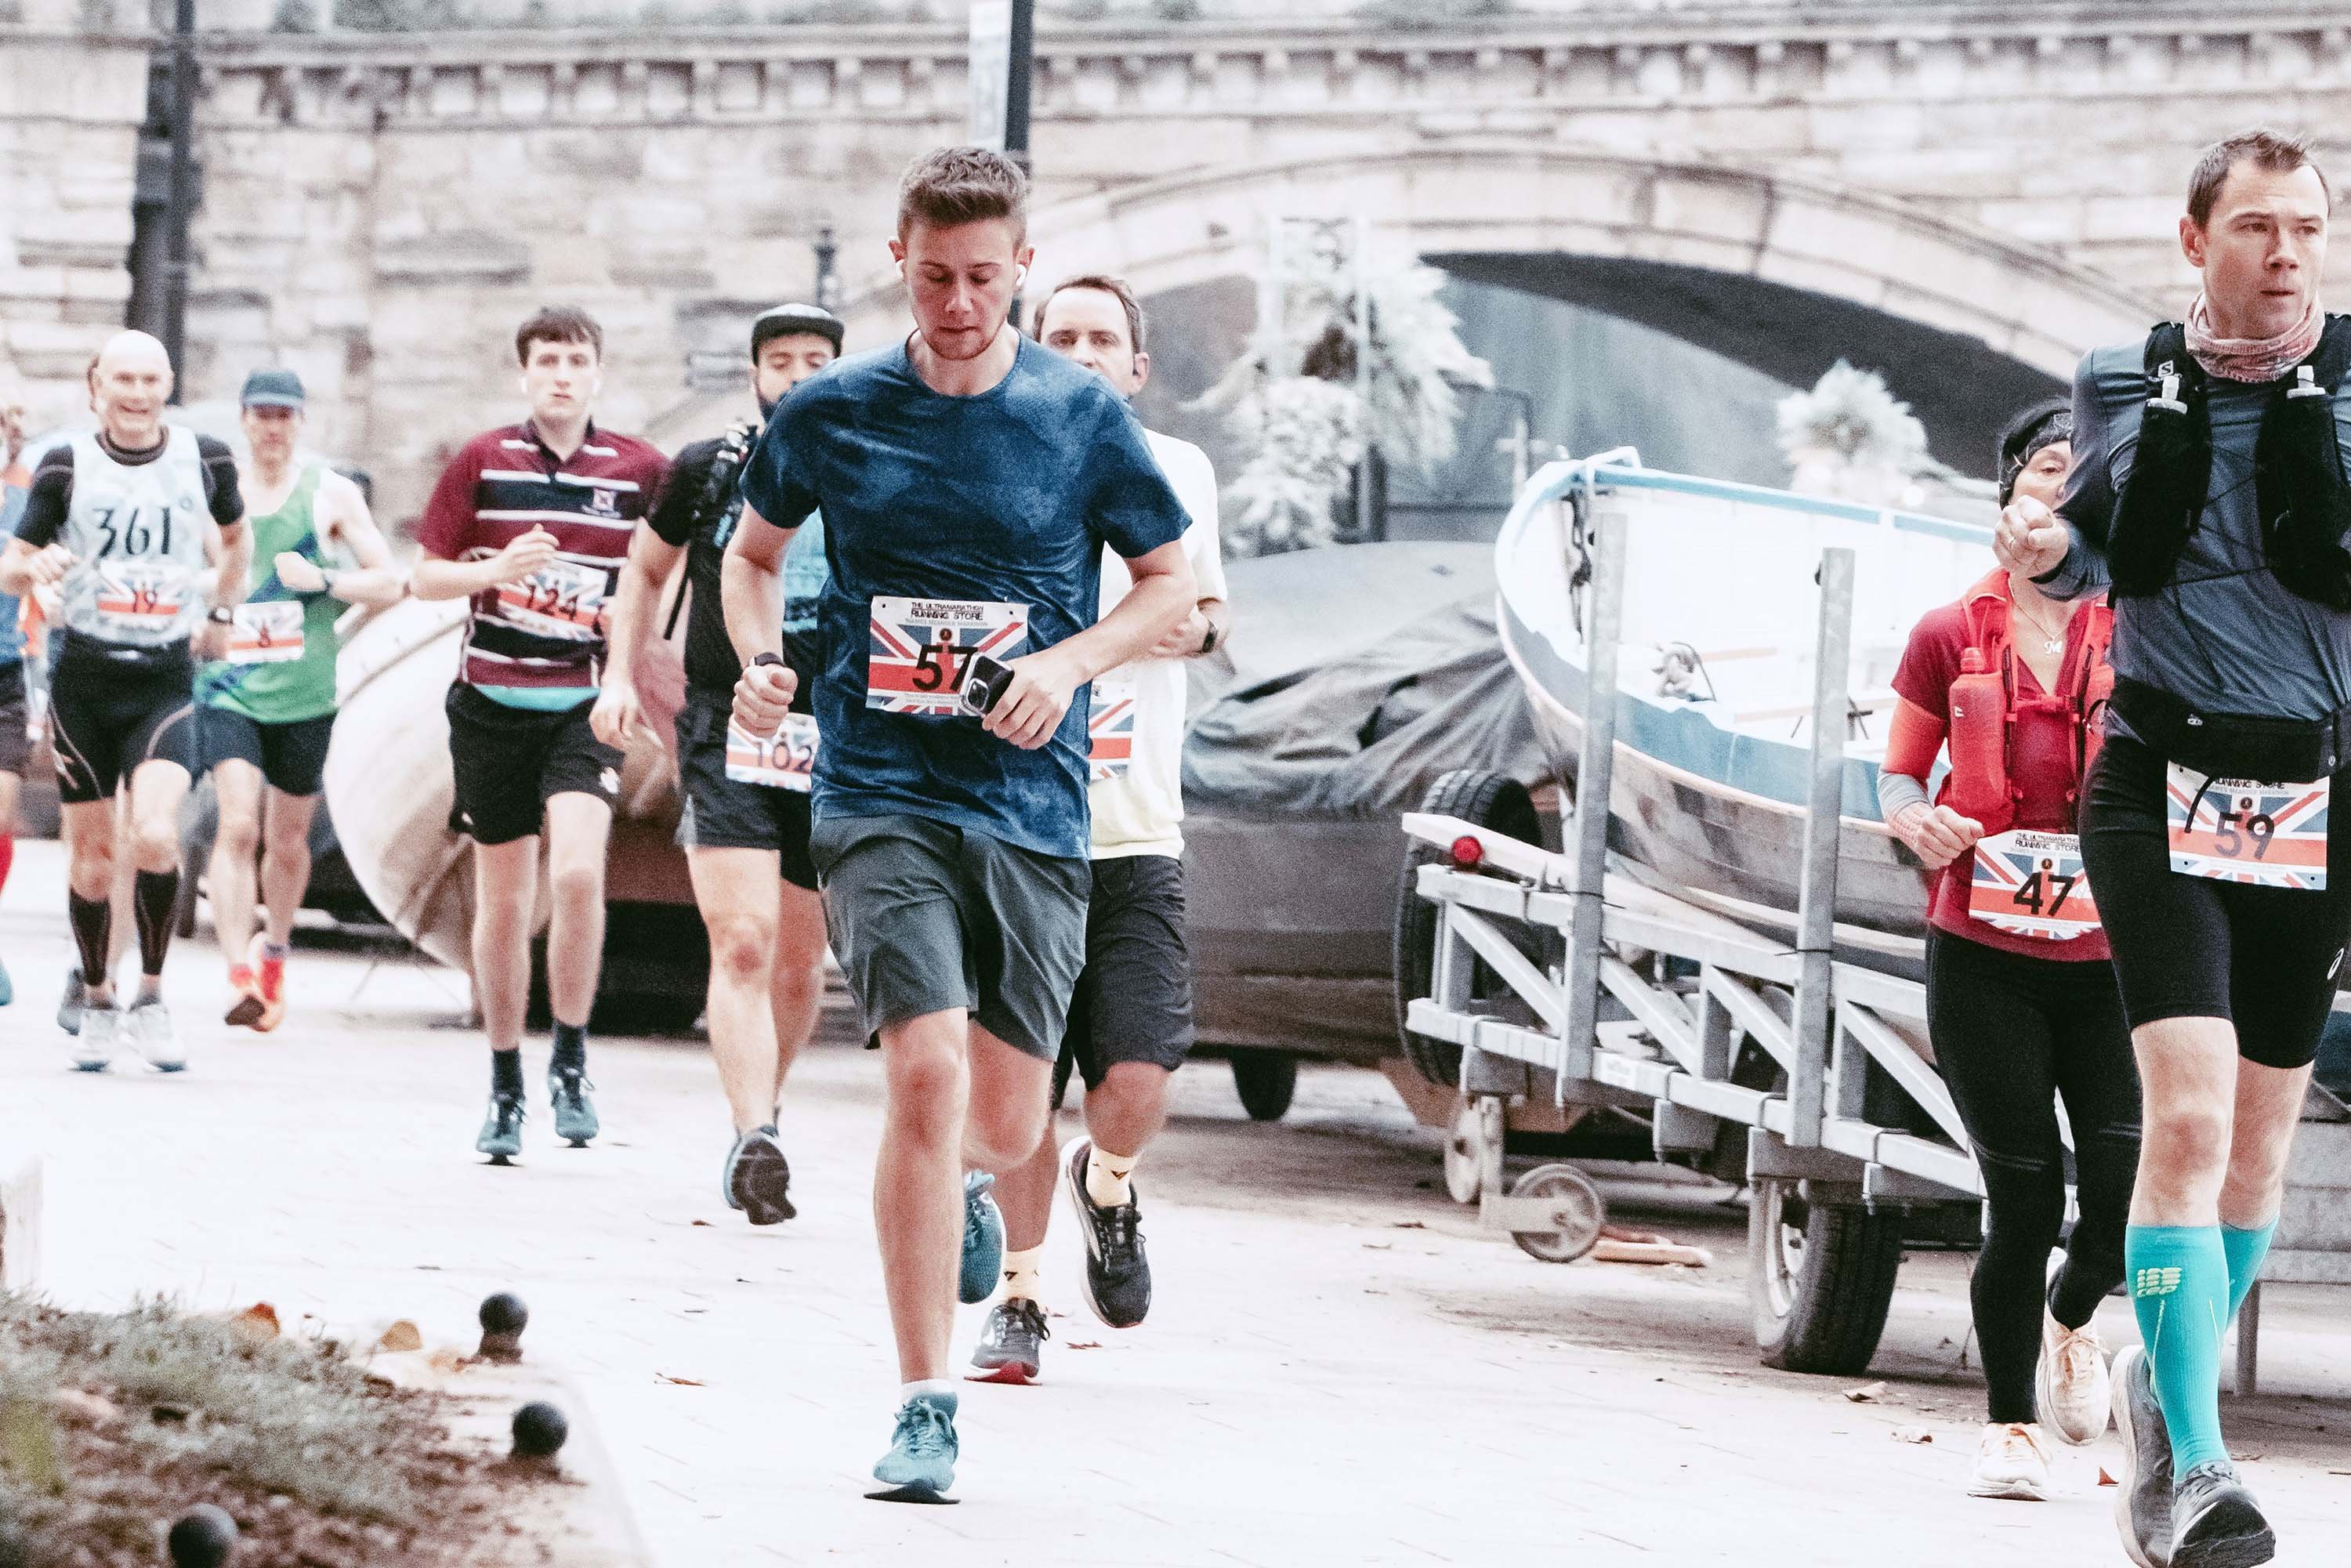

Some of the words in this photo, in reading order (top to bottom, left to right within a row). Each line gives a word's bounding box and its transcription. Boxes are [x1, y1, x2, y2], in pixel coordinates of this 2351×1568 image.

[92, 506, 171, 558] 361
[911, 610, 949, 619] RUNNING
[953, 611, 984, 621] STORE
[926, 603, 984, 611] ULTRAMARATHON
[912, 644, 978, 690] 57
[754, 741, 813, 775] 102
[2215, 778, 2252, 788] UNNING
[2015, 840, 2050, 850] RUNNING
[2055, 844, 2080, 853] STORE
[2030, 835, 2078, 843] ULTRAMARATHO
[2215, 812, 2274, 860] 59
[2013, 871, 2075, 916] 47
